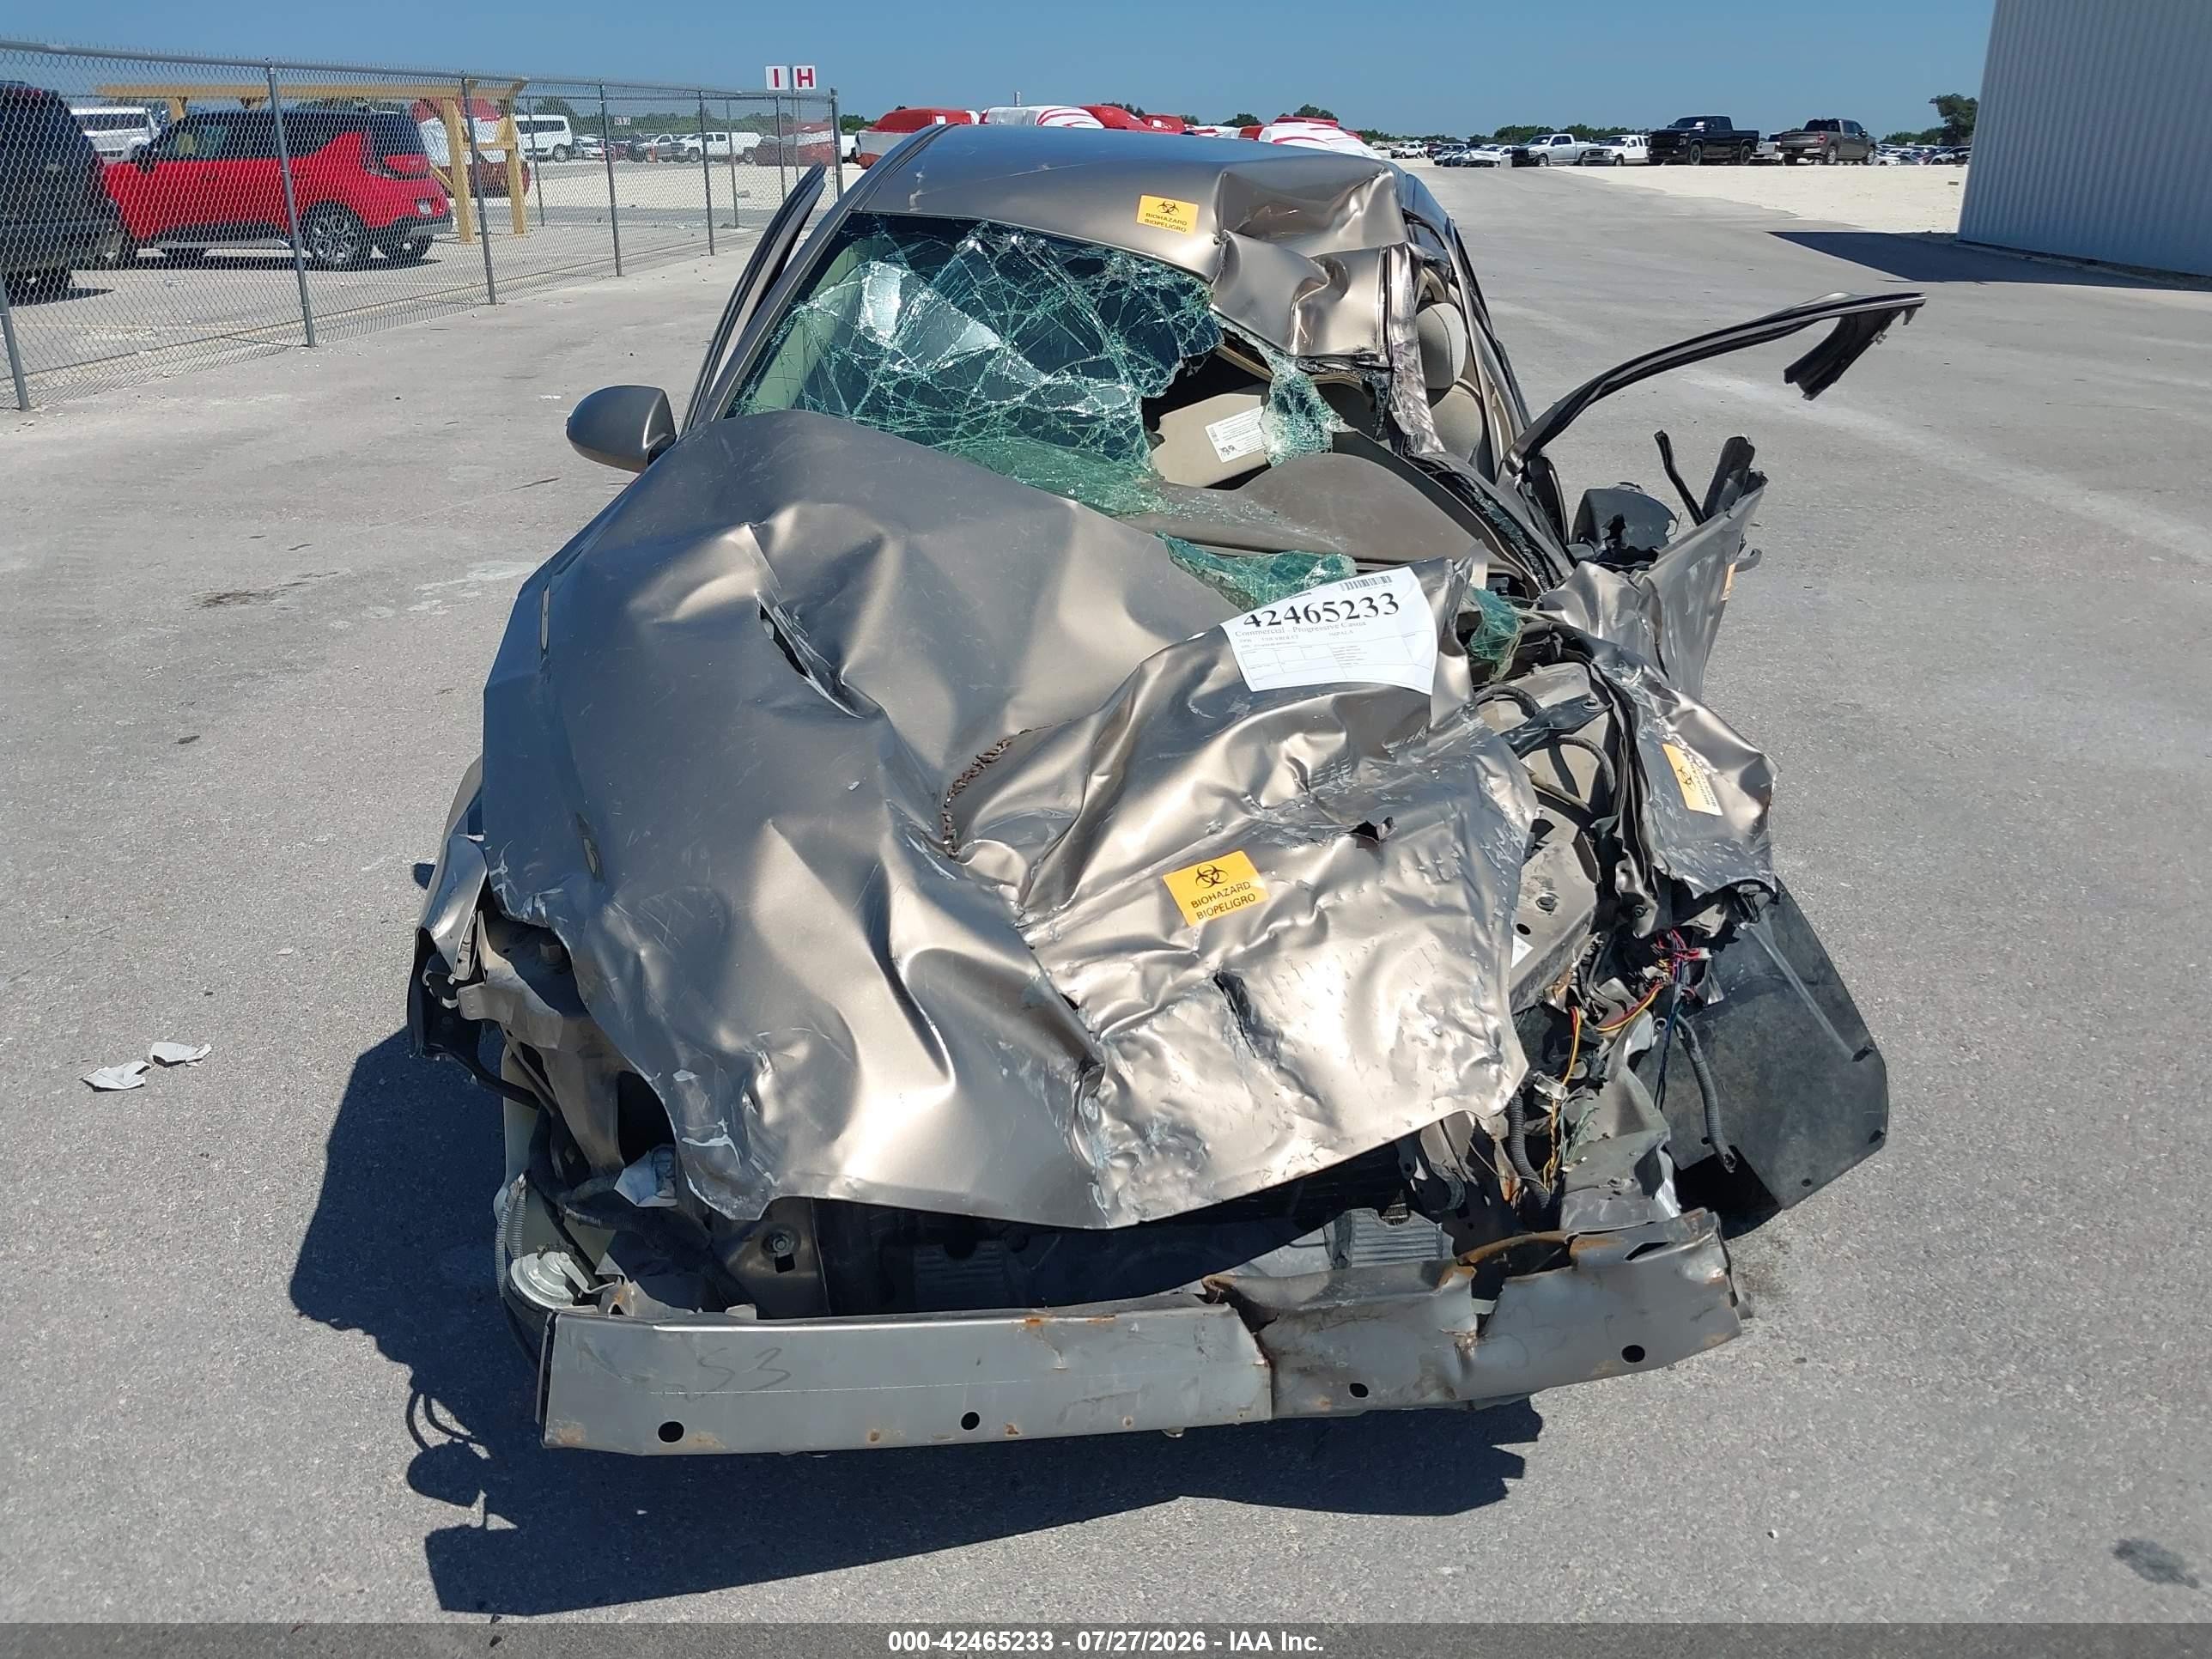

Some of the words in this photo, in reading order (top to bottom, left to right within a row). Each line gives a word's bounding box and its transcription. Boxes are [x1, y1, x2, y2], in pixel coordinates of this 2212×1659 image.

[774, 68, 780, 88] I
[796, 68, 813, 88] H
[1145, 218, 1187, 233] BIOPELIGRO
[1146, 212, 1188, 226] BIOHAZARD
[1243, 592, 1399, 629] 42465233
[1235, 626, 1285, 637] Commercial
[1292, 623, 1340, 635] Progressive
[1190, 881, 1250, 908] BIOHAZARD
[1196, 893, 1256, 920] BIOPELIGRO
